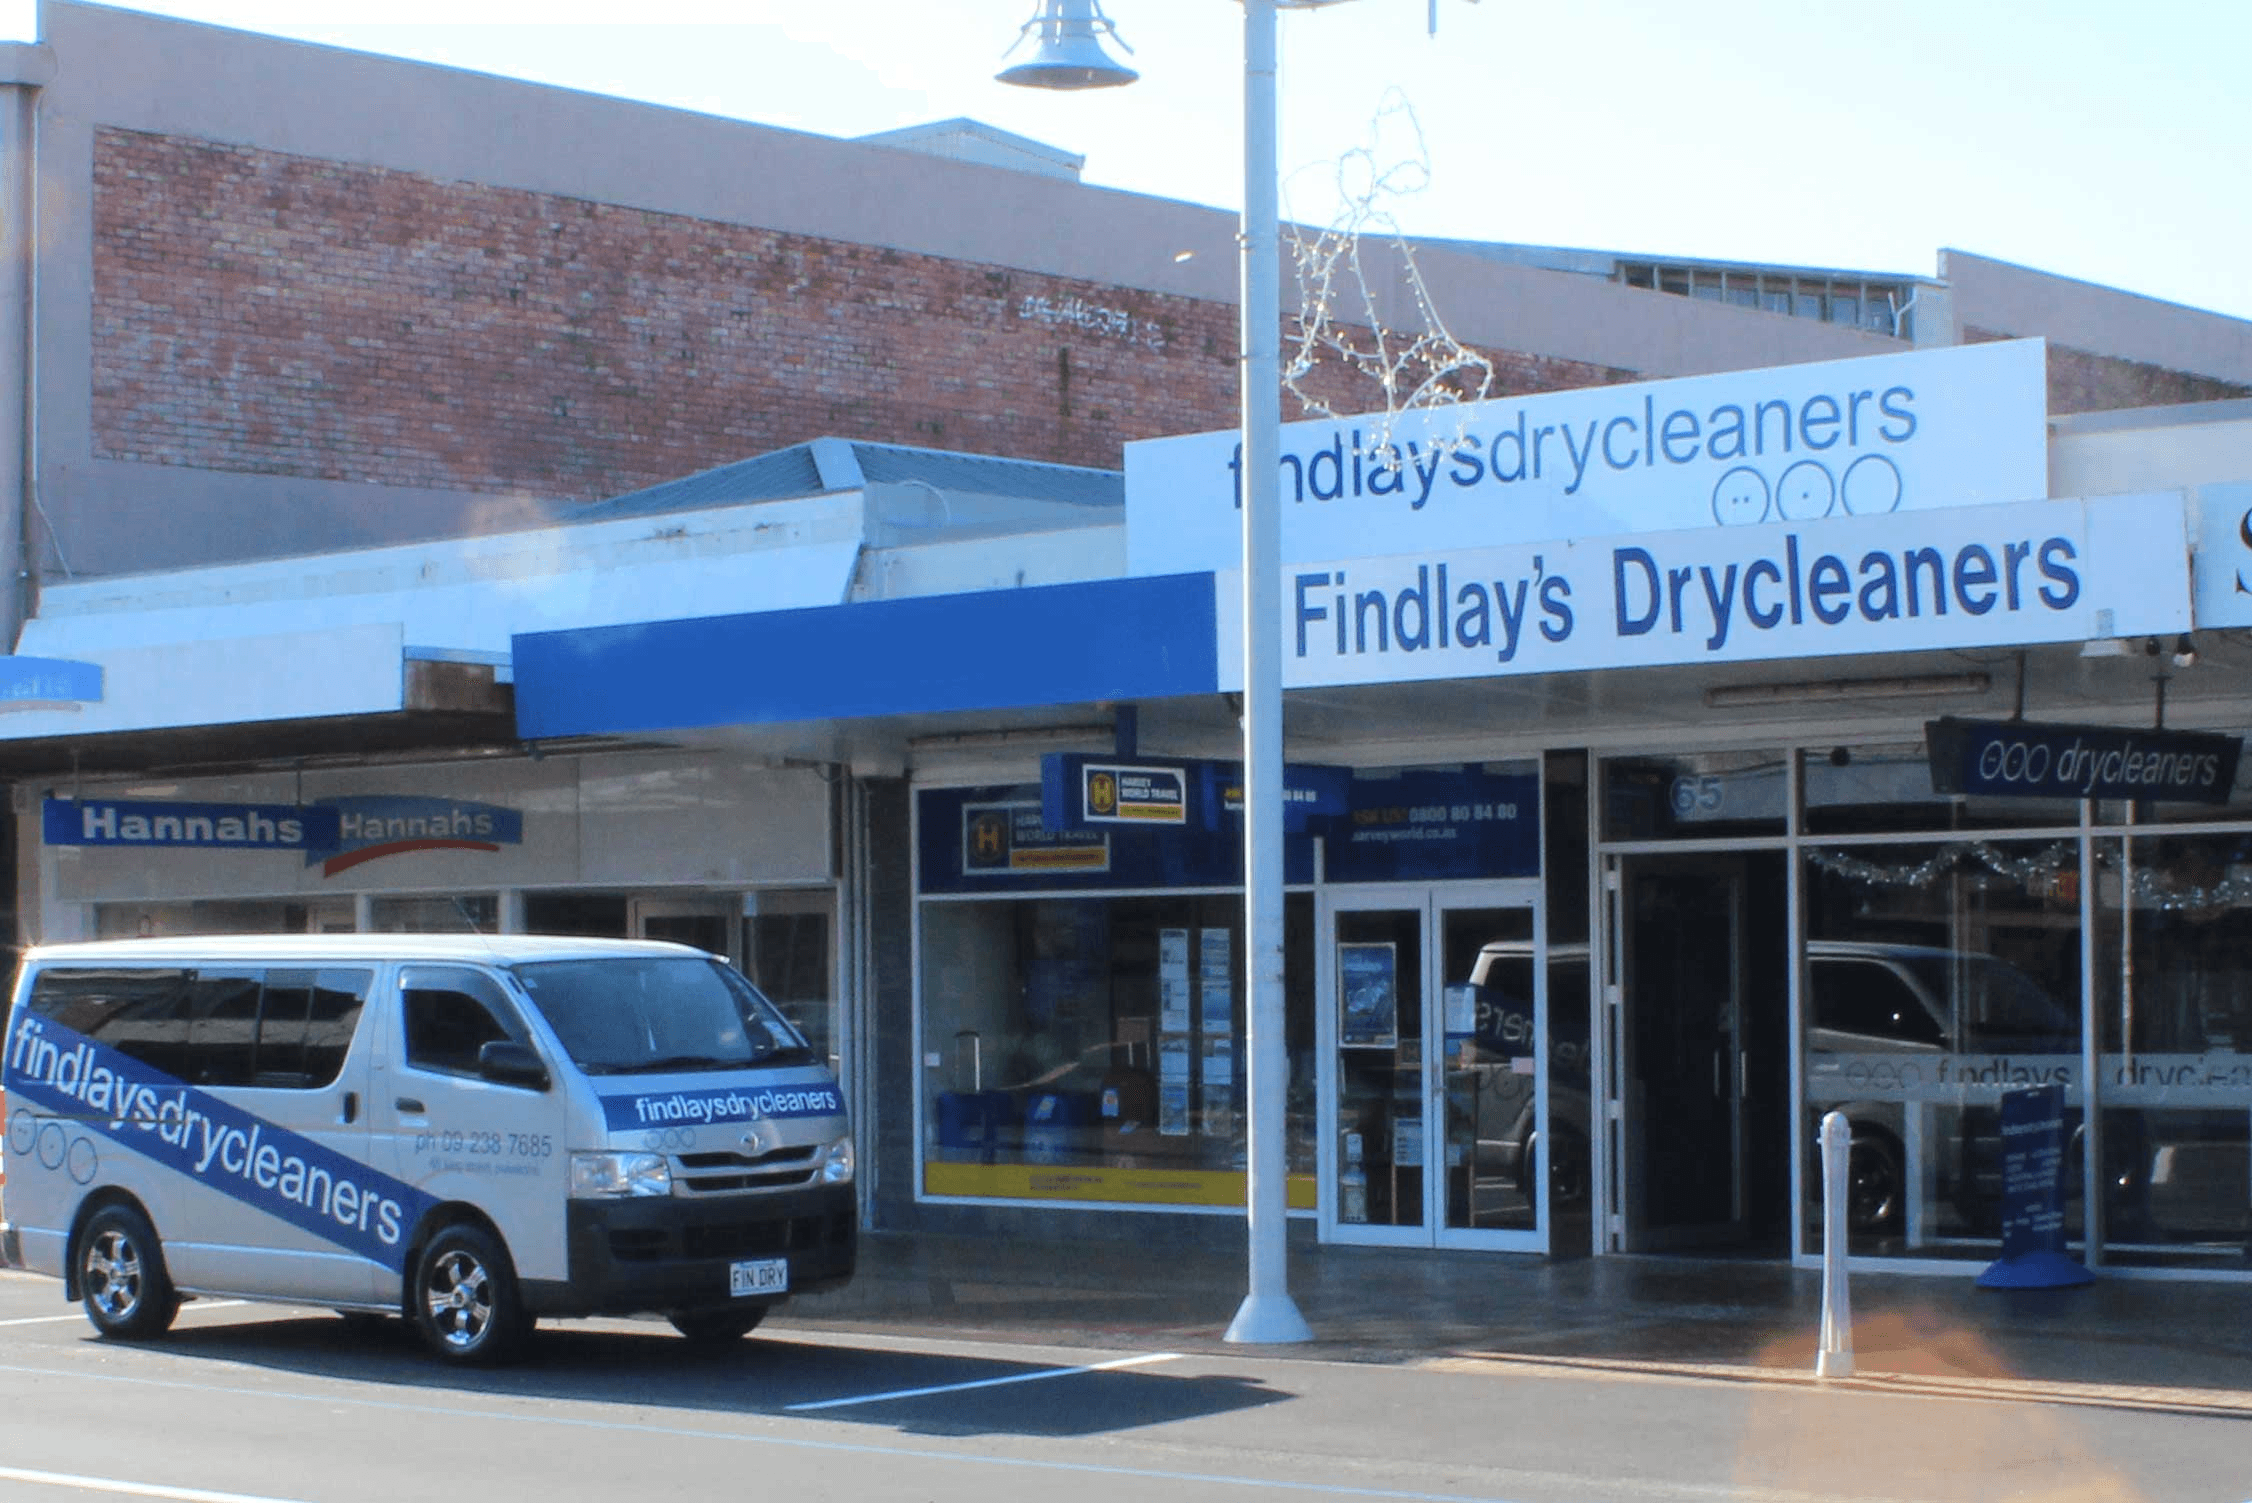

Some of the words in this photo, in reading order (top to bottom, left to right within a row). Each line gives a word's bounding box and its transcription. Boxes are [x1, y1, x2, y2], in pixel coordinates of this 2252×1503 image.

[1229, 385, 1917, 511] fndlaysdrycleaners
[1295, 555, 1574, 662] Findlay's
[1612, 534, 2081, 651] Drycleaners
[2056, 737, 2219, 794] drycleaners
[1671, 778, 1720, 812] 65
[82, 806, 305, 844] Hannahs
[339, 807, 494, 840] Hannahs
[1938, 1058, 2071, 1084] fndlays
[635, 1090, 837, 1123] findlaysdrycleaners
[11, 1018, 402, 1245] findlaysdrycleaners
[415, 1130, 436, 1155] ph
[442, 1130, 463, 1152] 09
[469, 1131, 501, 1155] 238
[508, 1132, 552, 1157] 7685
[732, 1268, 754, 1288] FIN
[759, 1266, 786, 1287] DRY
